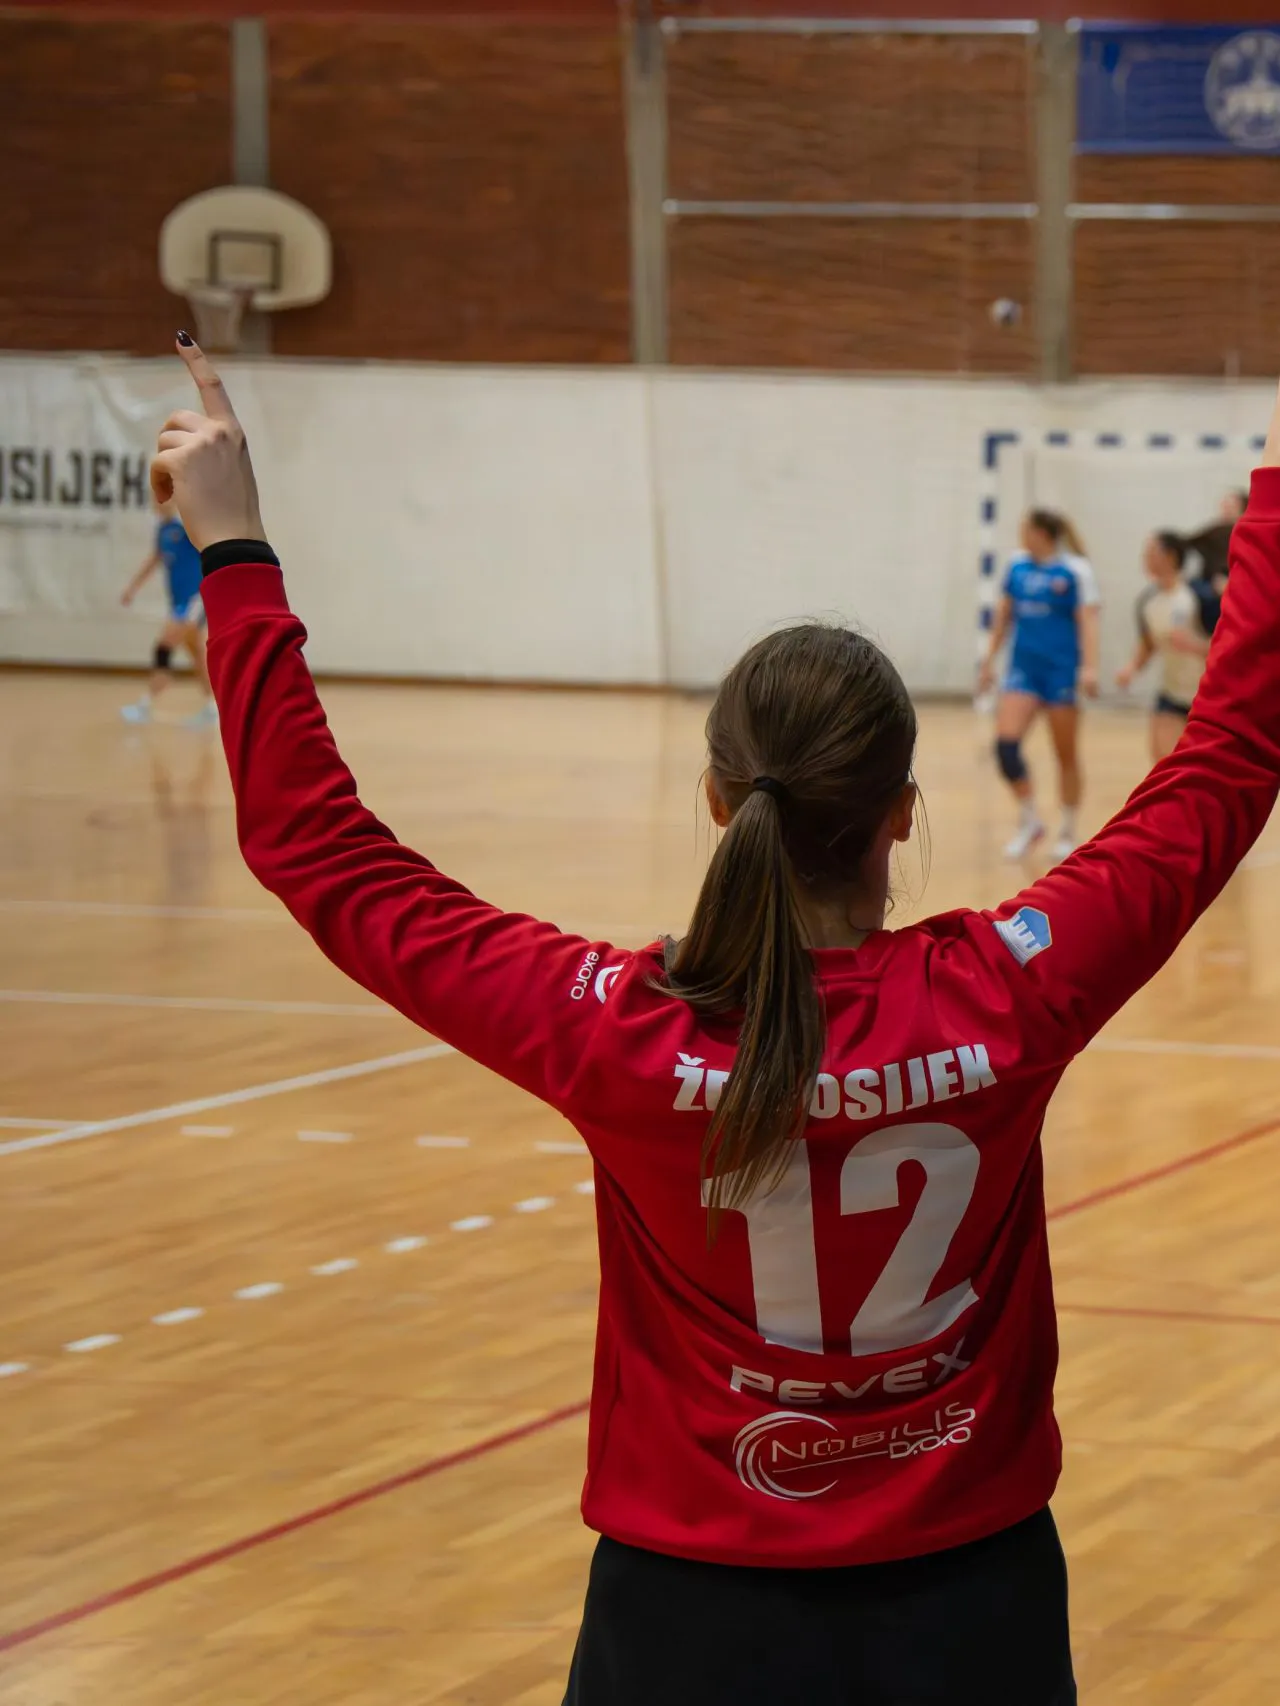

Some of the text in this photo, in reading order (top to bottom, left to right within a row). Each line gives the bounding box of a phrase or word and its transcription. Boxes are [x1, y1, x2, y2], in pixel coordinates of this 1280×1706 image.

[0, 447, 149, 509] SIJEK
[808, 1044, 998, 1121] OSIJEK
[701, 1122, 981, 1358] 12
[729, 1336, 971, 1405] PEVEX
[772, 1401, 976, 1463] NOBILIS
